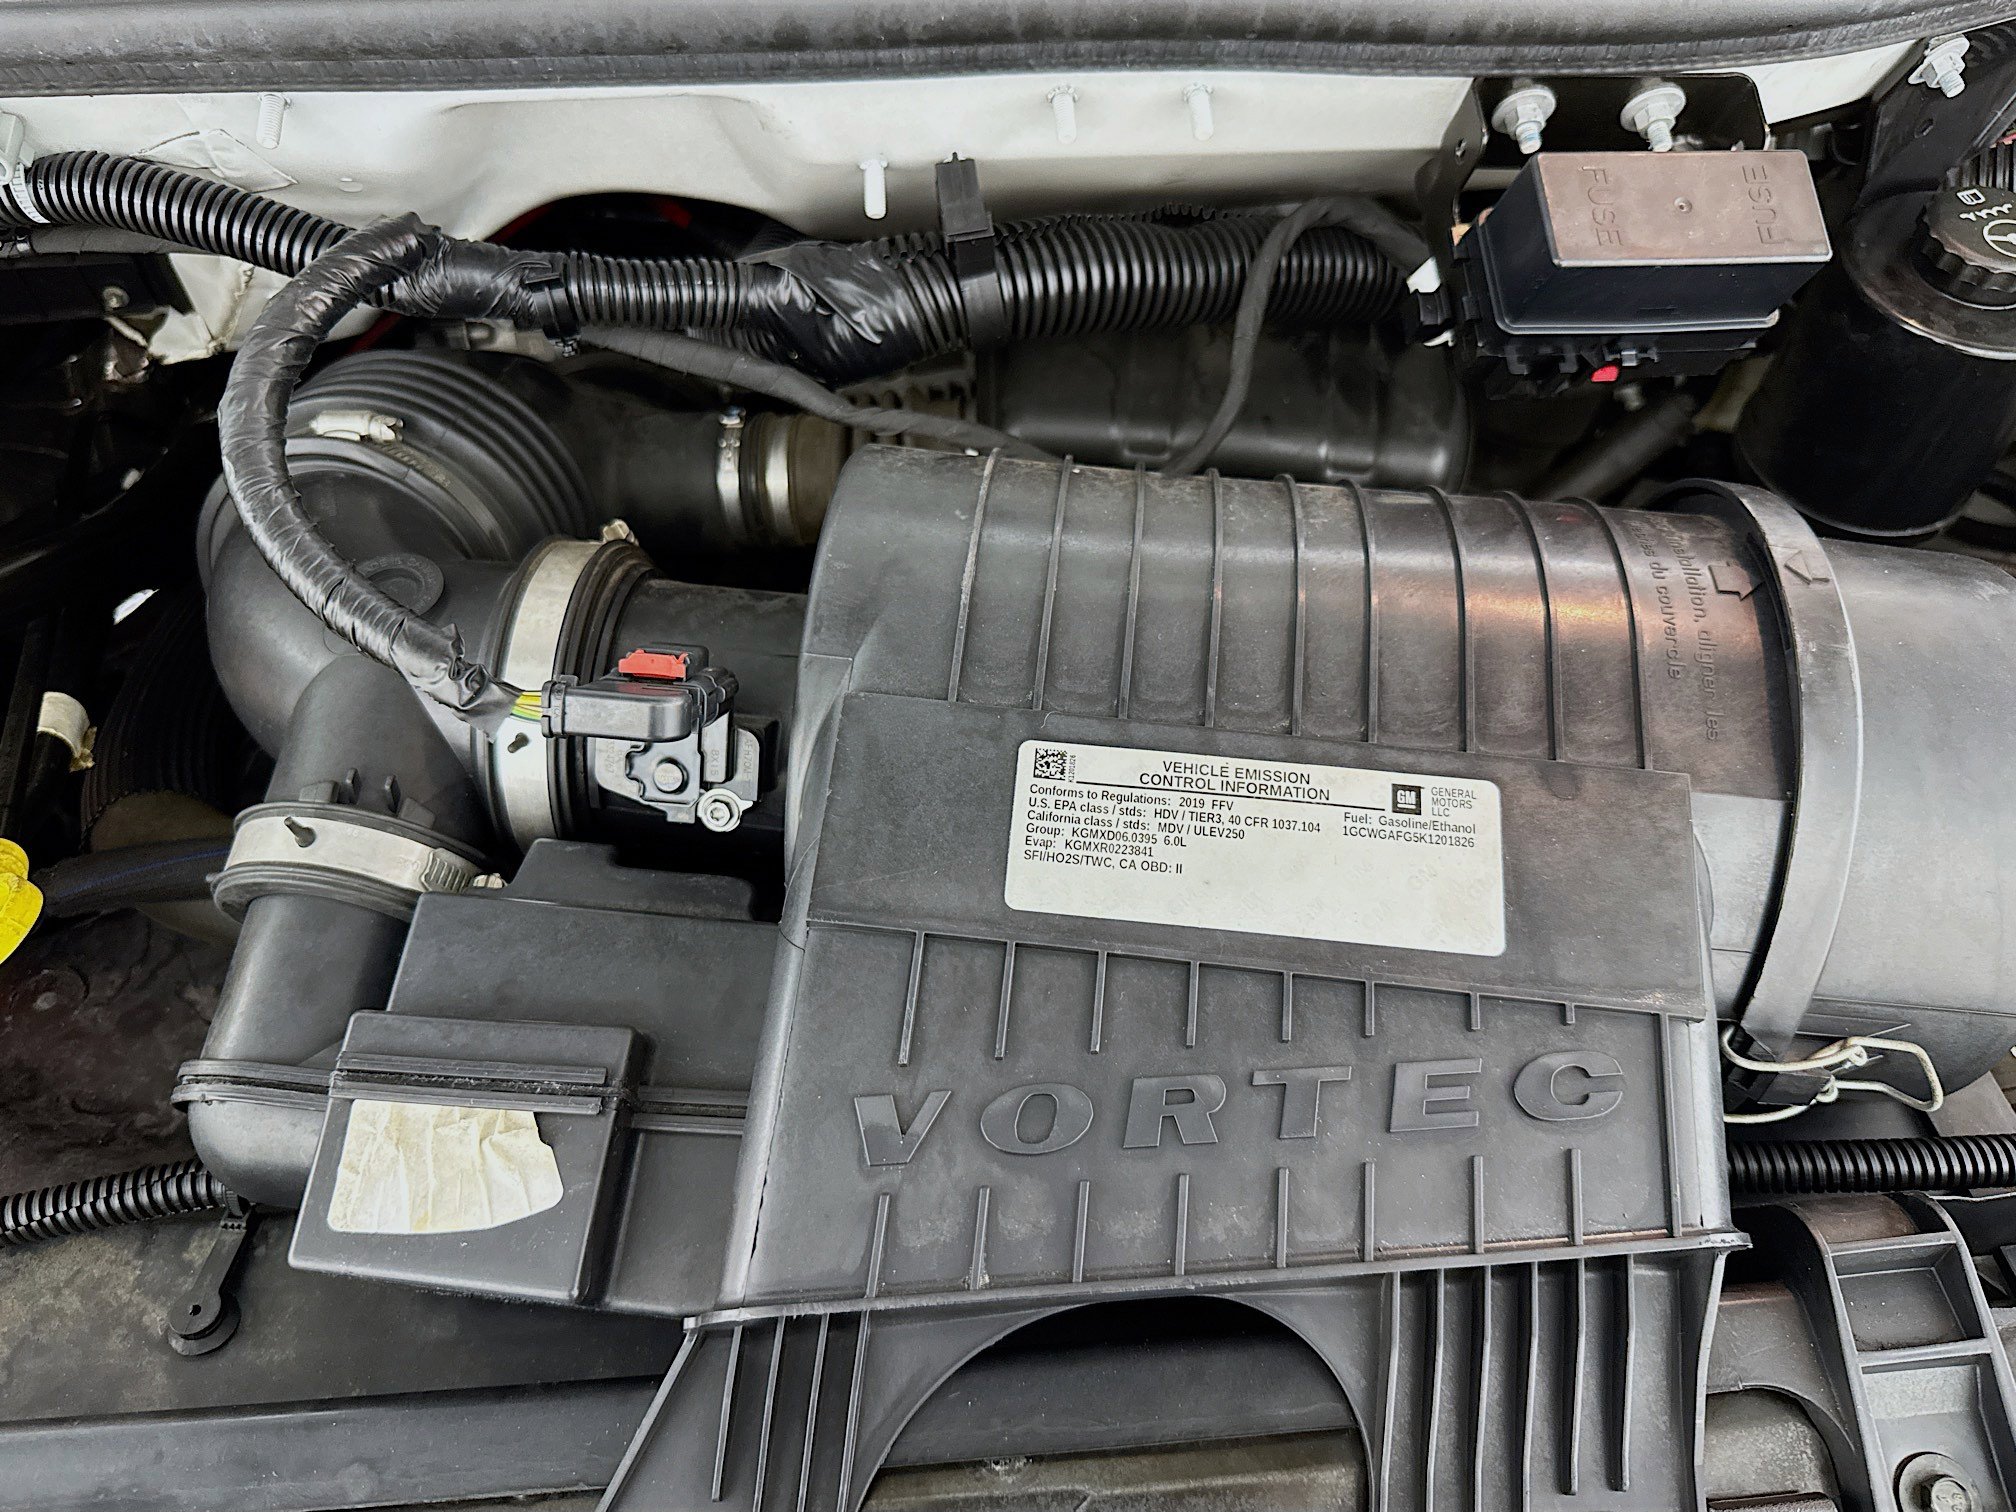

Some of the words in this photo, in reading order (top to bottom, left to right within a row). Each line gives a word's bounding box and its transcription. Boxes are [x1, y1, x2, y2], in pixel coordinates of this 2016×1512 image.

[1579, 165, 1624, 247] FUSE
[1742, 165, 1788, 246] FUSE
[1649, 561, 1669, 580] du
[1655, 585, 1687, 681] couvercle
[1694, 629, 1718, 698] aligner
[1705, 711, 1726, 742] les
[1162, 760, 1229, 778] VEHICLE
[1234, 768, 1311, 785] EMISSION
[1029, 783, 1084, 799] Conforms
[1086, 788, 1098, 800] to
[1101, 790, 1171, 807] Regulations:
[1179, 797, 1205, 809] 2019
[1211, 799, 1234, 811] FFV
[1139, 773, 1216, 791] CONTROL
[1220, 779, 1331, 801] INFORMATION
[1396, 789, 1417, 805] GM
[1430, 786, 1478, 800] GENERAL
[1028, 797, 1050, 809] U.S.
[1054, 799, 1077, 812] EPA
[1080, 801, 1108, 815] class
[1118, 805, 1147, 818] stds:
[1154, 808, 1180, 821] HDV
[1189, 811, 1225, 825] TIER3,
[1228, 814, 1242, 826] 40
[1244, 815, 1269, 829] CFR
[1272, 818, 1321, 833] 1037.104
[1431, 798, 1473, 810] MOTORS
[1431, 807, 1450, 818] LLC
[1025, 822, 1065, 838] Group:
[1071, 826, 1158, 845] KGMXD06.0395
[1163, 835, 1187, 848] 6.0L
[1027, 810, 1081, 825] California
[1083, 814, 1113, 828] class
[1122, 818, 1151, 831] stds:
[1157, 821, 1185, 834] MDV
[1193, 825, 1246, 840] ULEV250
[1342, 825, 1475, 848] 1GCWGAFG5K1201826
[1343, 812, 1373, 826] Fuel:
[1378, 815, 1476, 835] Gasoline/Ethanol
[1025, 835, 1056, 850] Evap:
[1064, 838, 1154, 858] KGMXR0223841
[1023, 849, 1115, 870] SFI/HO2S/TWC,
[1119, 858, 1137, 871] CA
[1140, 860, 1172, 874] OBD:
[1175, 863, 1183, 875] II
[854, 1050, 1624, 1167] VORTEC
